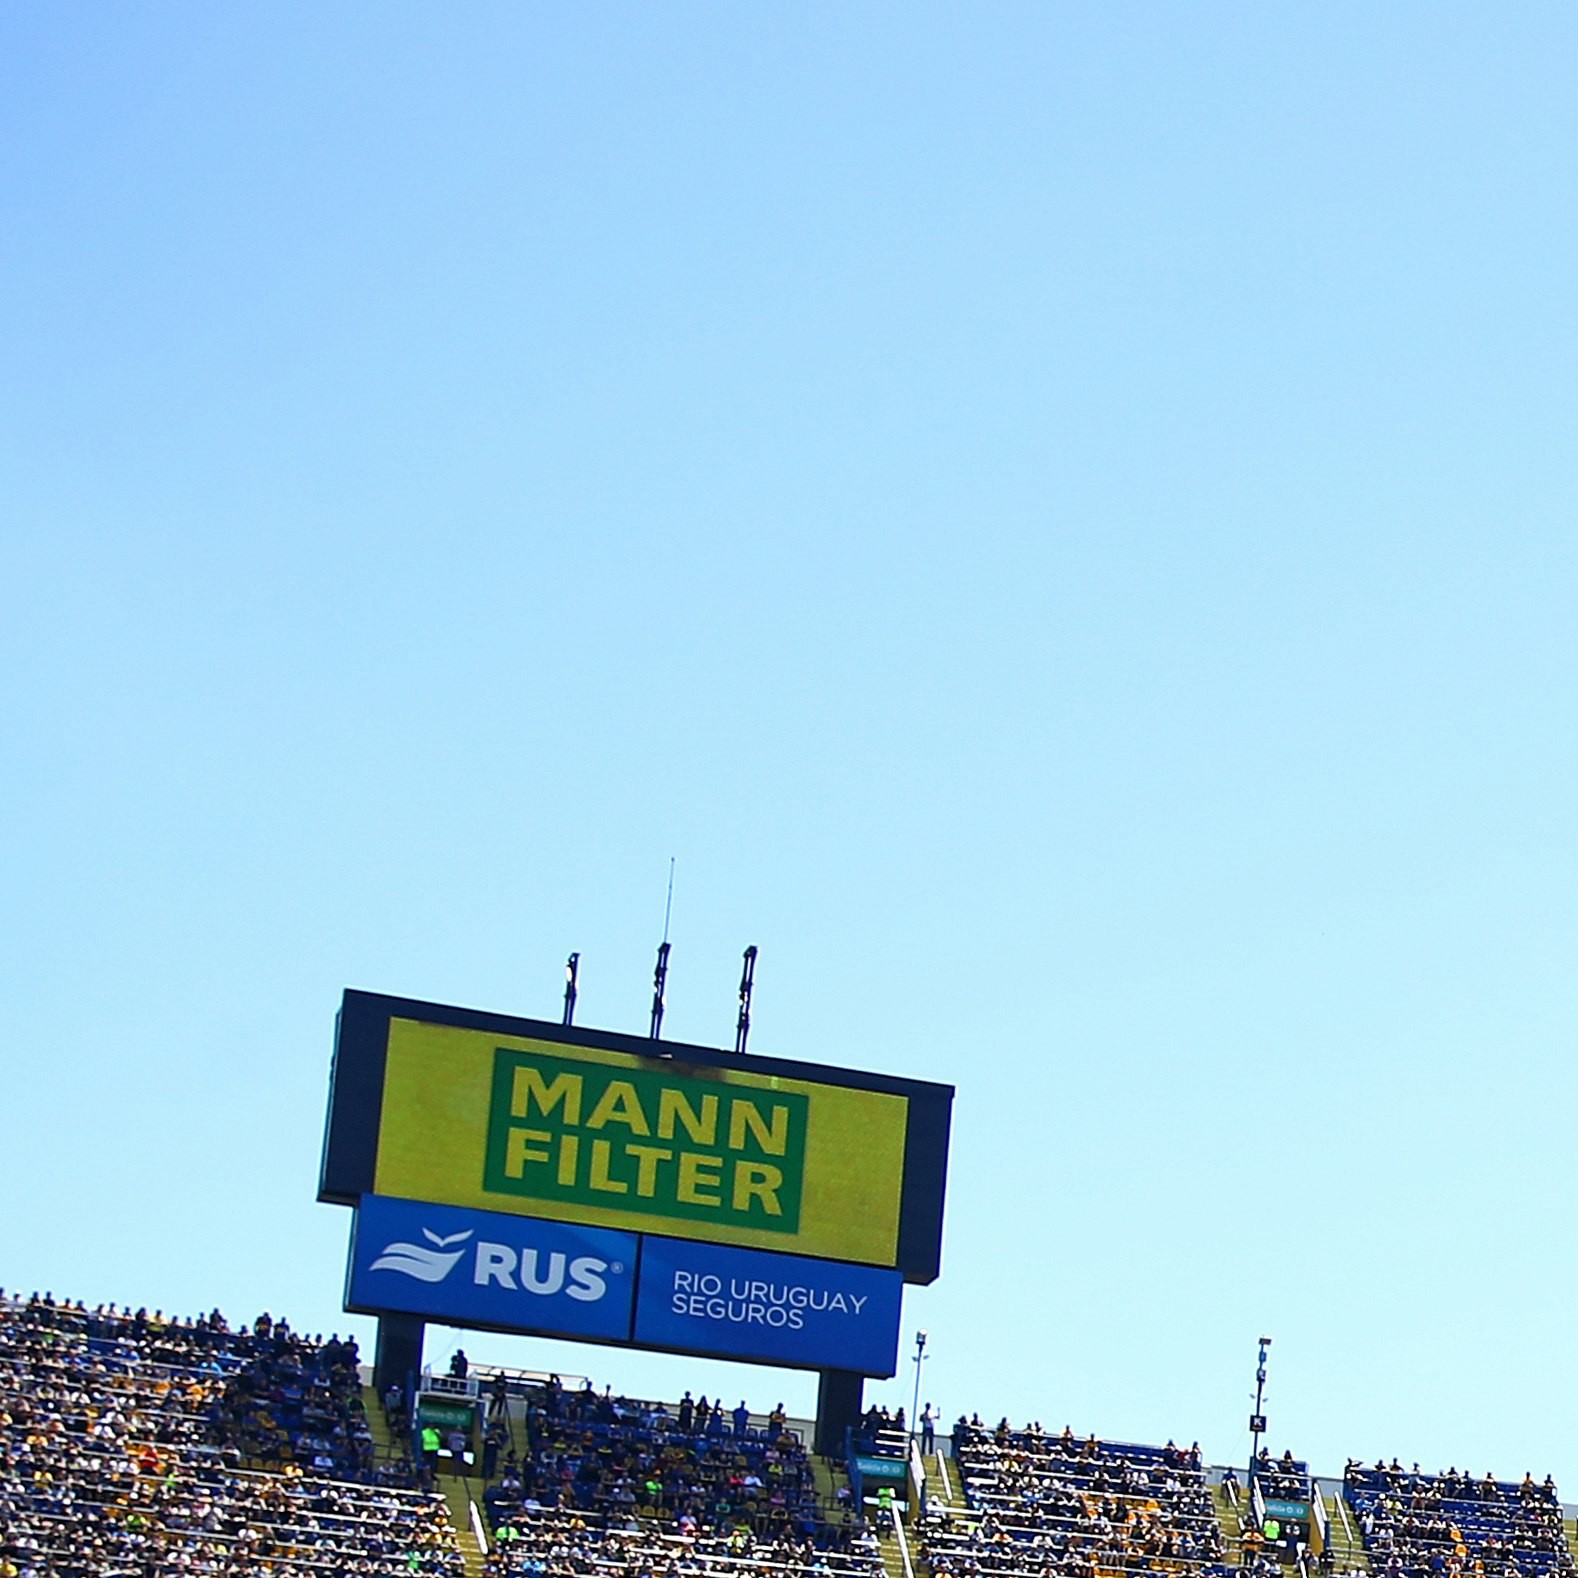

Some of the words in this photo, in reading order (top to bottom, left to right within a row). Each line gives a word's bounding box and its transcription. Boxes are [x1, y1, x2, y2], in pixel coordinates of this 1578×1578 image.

[511, 1066, 788, 1156] MANN
[503, 1127, 783, 1216] FILTER
[474, 1241, 607, 1302] RUS
[673, 1271, 721, 1296] RIO
[731, 1279, 868, 1315] URUGUAY
[671, 1293, 804, 1330] SEGUROS
